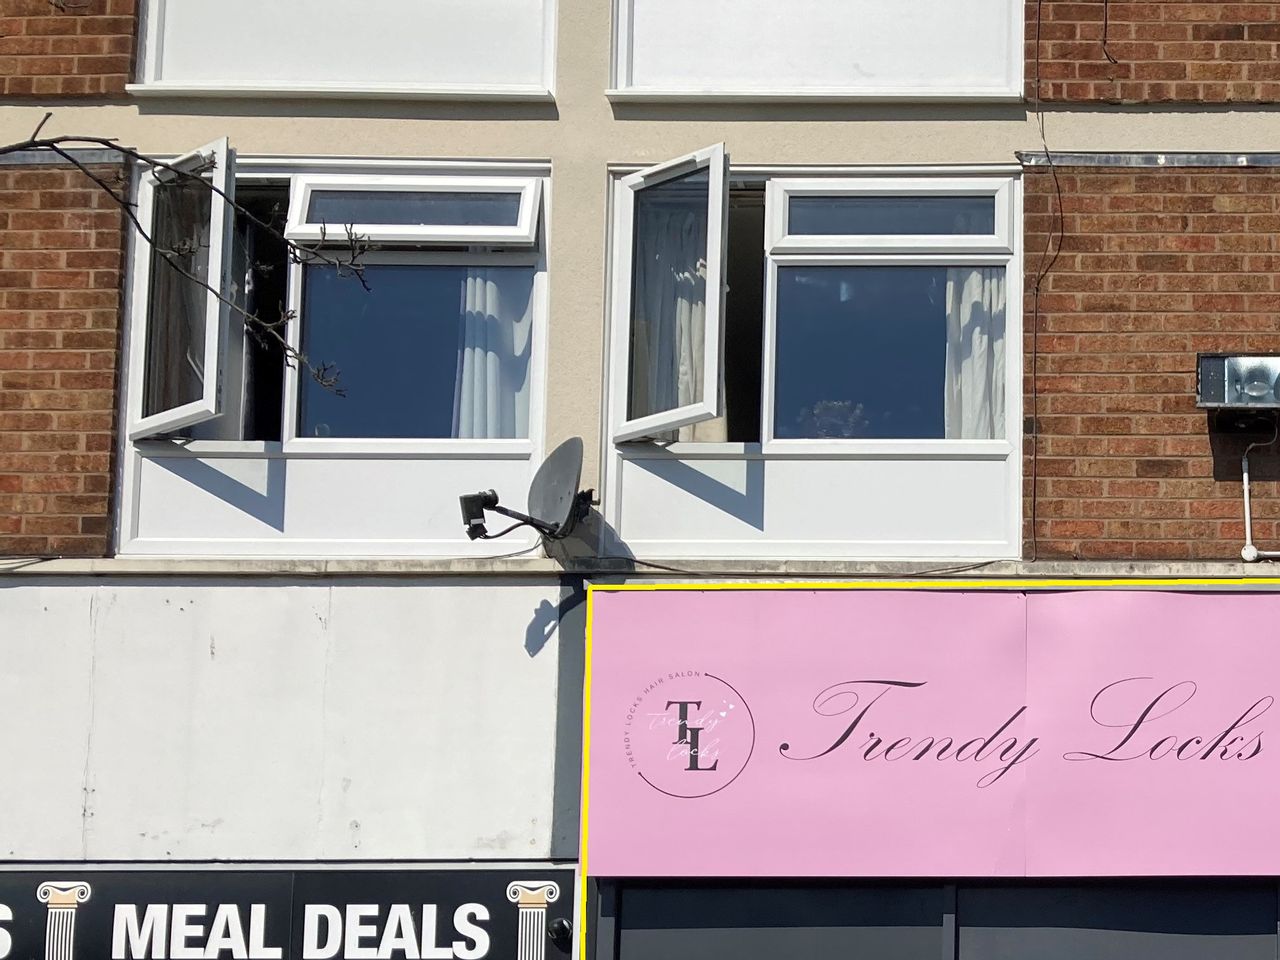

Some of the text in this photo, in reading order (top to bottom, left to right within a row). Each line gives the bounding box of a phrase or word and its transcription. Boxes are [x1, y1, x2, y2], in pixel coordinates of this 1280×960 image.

[624, 670, 701, 769] TRENDY LOCKS HAIR SALON
[779, 680, 1040, 789] Trendy
[1062, 677, 1274, 762] Locks
[111, 903, 491, 960] MEAL DEALS
